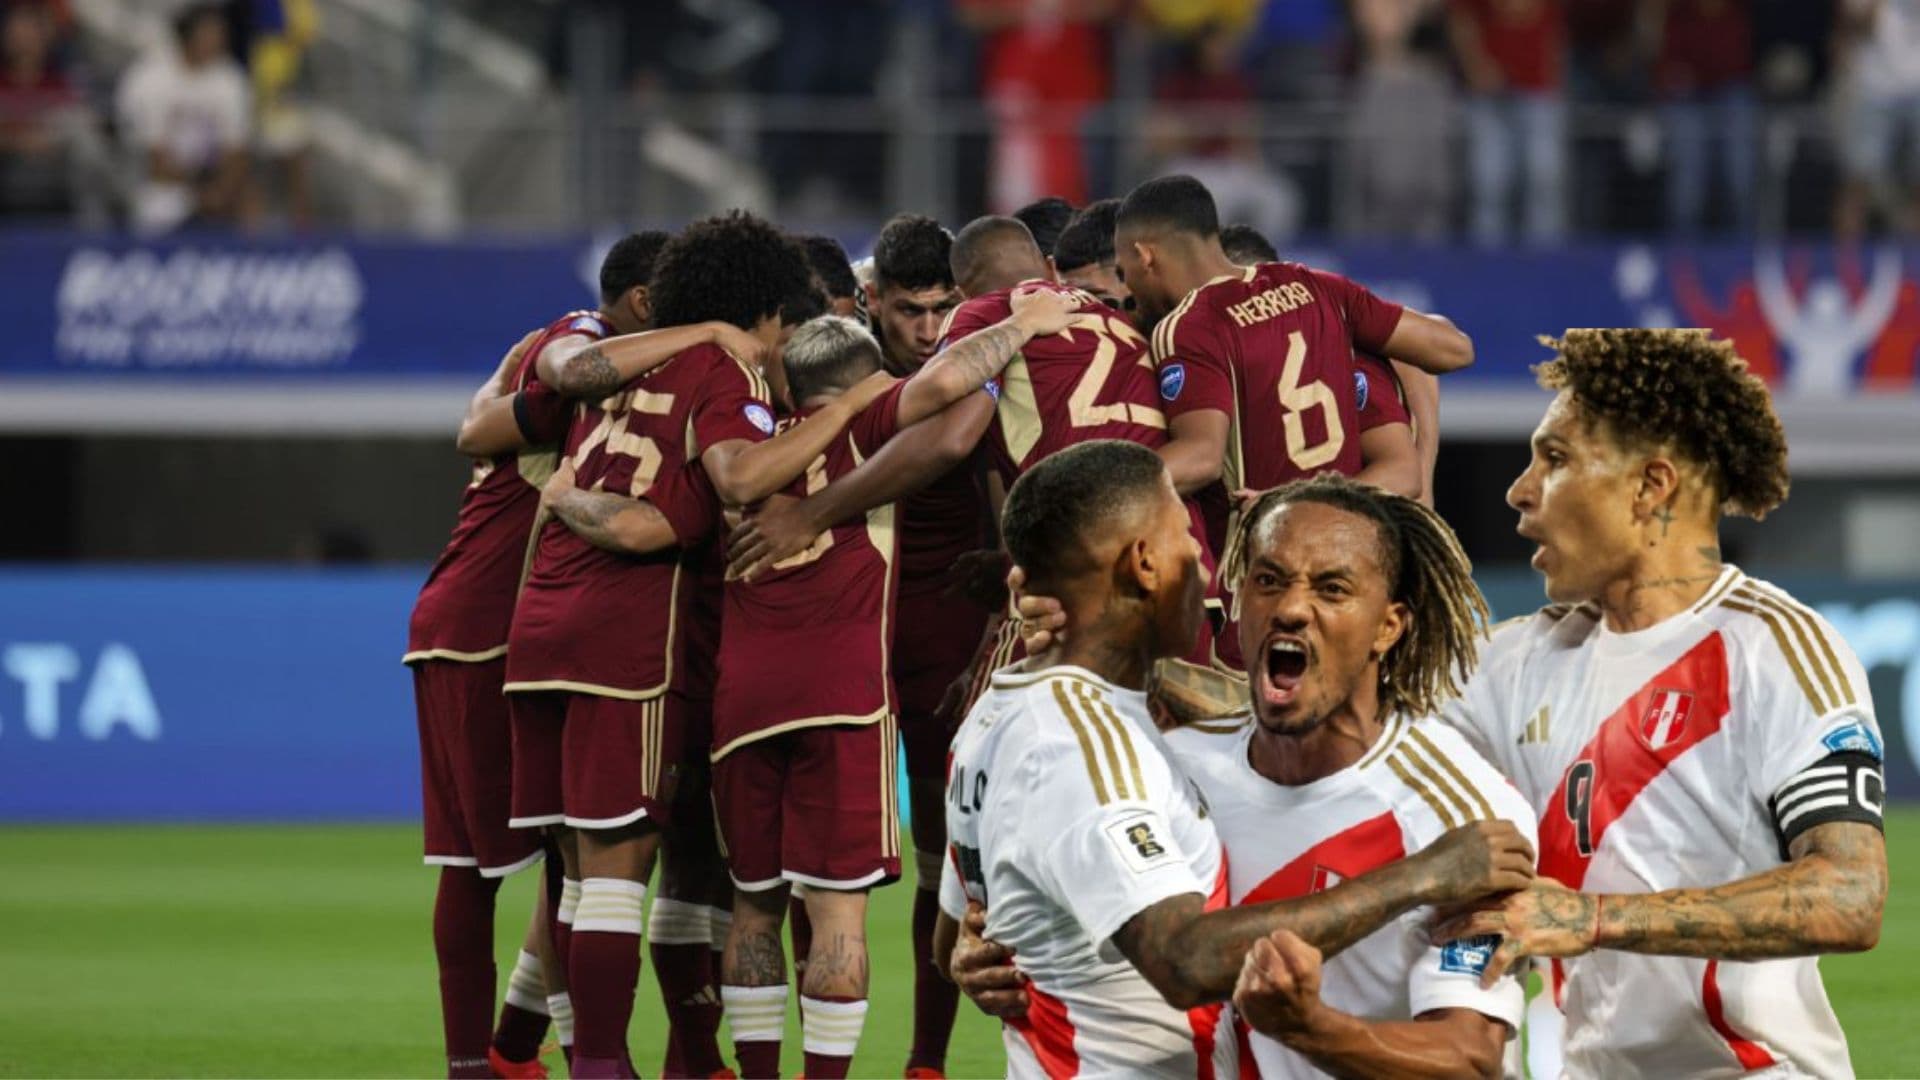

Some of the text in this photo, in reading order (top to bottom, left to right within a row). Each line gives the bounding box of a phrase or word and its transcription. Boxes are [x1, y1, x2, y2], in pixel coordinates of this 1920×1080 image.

[1278, 330, 1345, 471] 6
[0, 642, 163, 742] TA
[1566, 759, 1595, 857] 9
